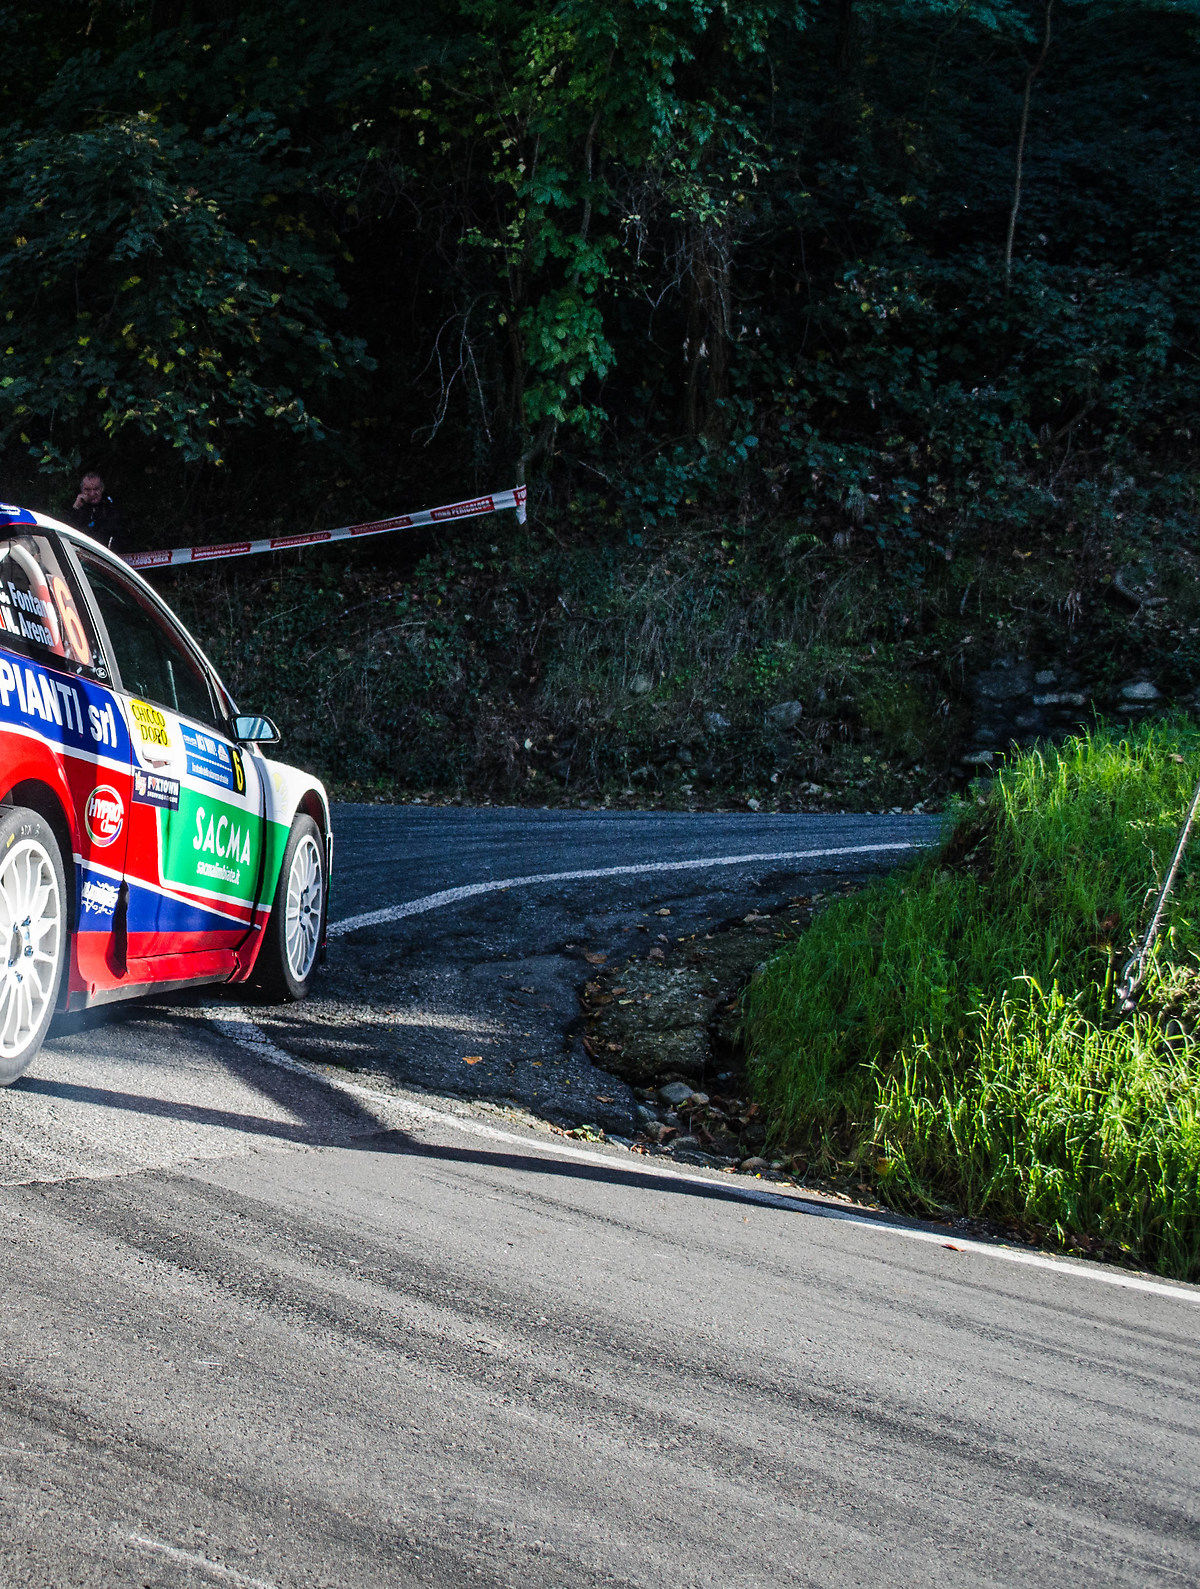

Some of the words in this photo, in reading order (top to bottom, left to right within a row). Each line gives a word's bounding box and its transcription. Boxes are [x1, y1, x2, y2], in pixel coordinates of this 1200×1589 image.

[18, 612, 55, 647] Arena
[52, 577, 90, 666] 6
[88, 703, 118, 748] srl
[131, 704, 165, 727] CHICCO
[233, 749, 244, 791] 6
[89, 797, 122, 823] HYPRO
[192, 806, 251, 867] SACMA
